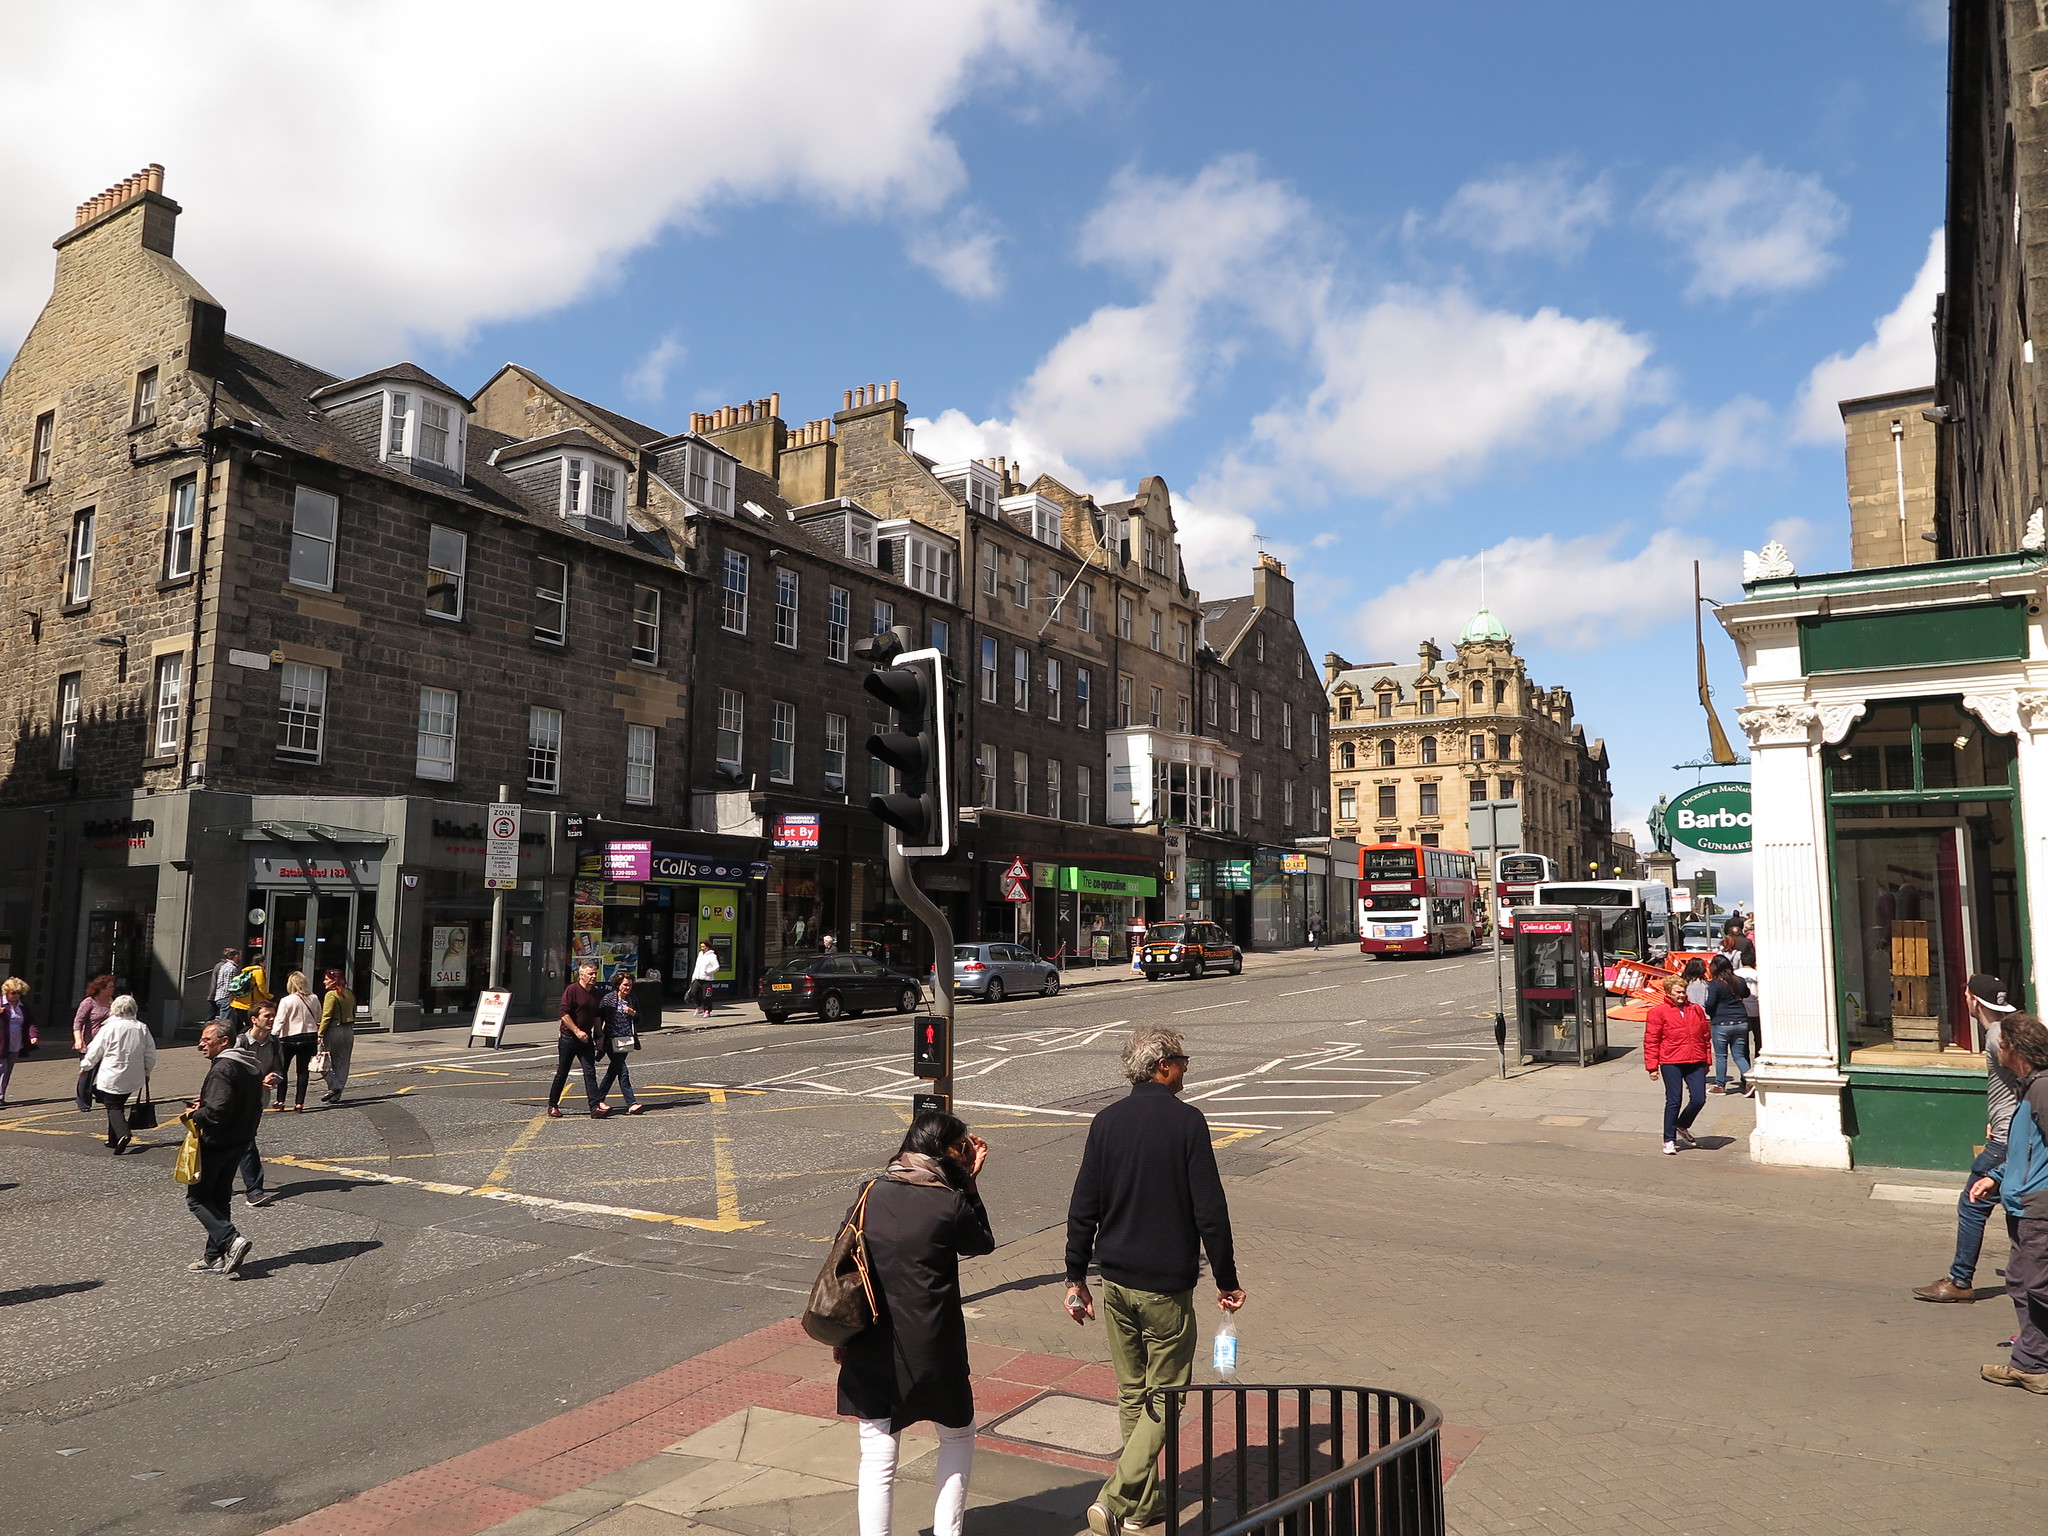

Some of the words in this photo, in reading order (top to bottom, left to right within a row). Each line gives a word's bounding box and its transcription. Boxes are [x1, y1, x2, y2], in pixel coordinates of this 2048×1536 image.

[1677, 807, 1752, 829] Barbo
[778, 827, 796, 837] Let
[799, 826, 814, 839] By
[1697, 838, 1752, 851] GUNMAKE
[1082, 876, 1092, 888] The
[1092, 879, 1127, 892] co-operative
[1127, 881, 1139, 892] food
[1522, 923, 1539, 931] Coins
[1544, 923, 1561, 931] Cards
[436, 971, 461, 982] SALE
